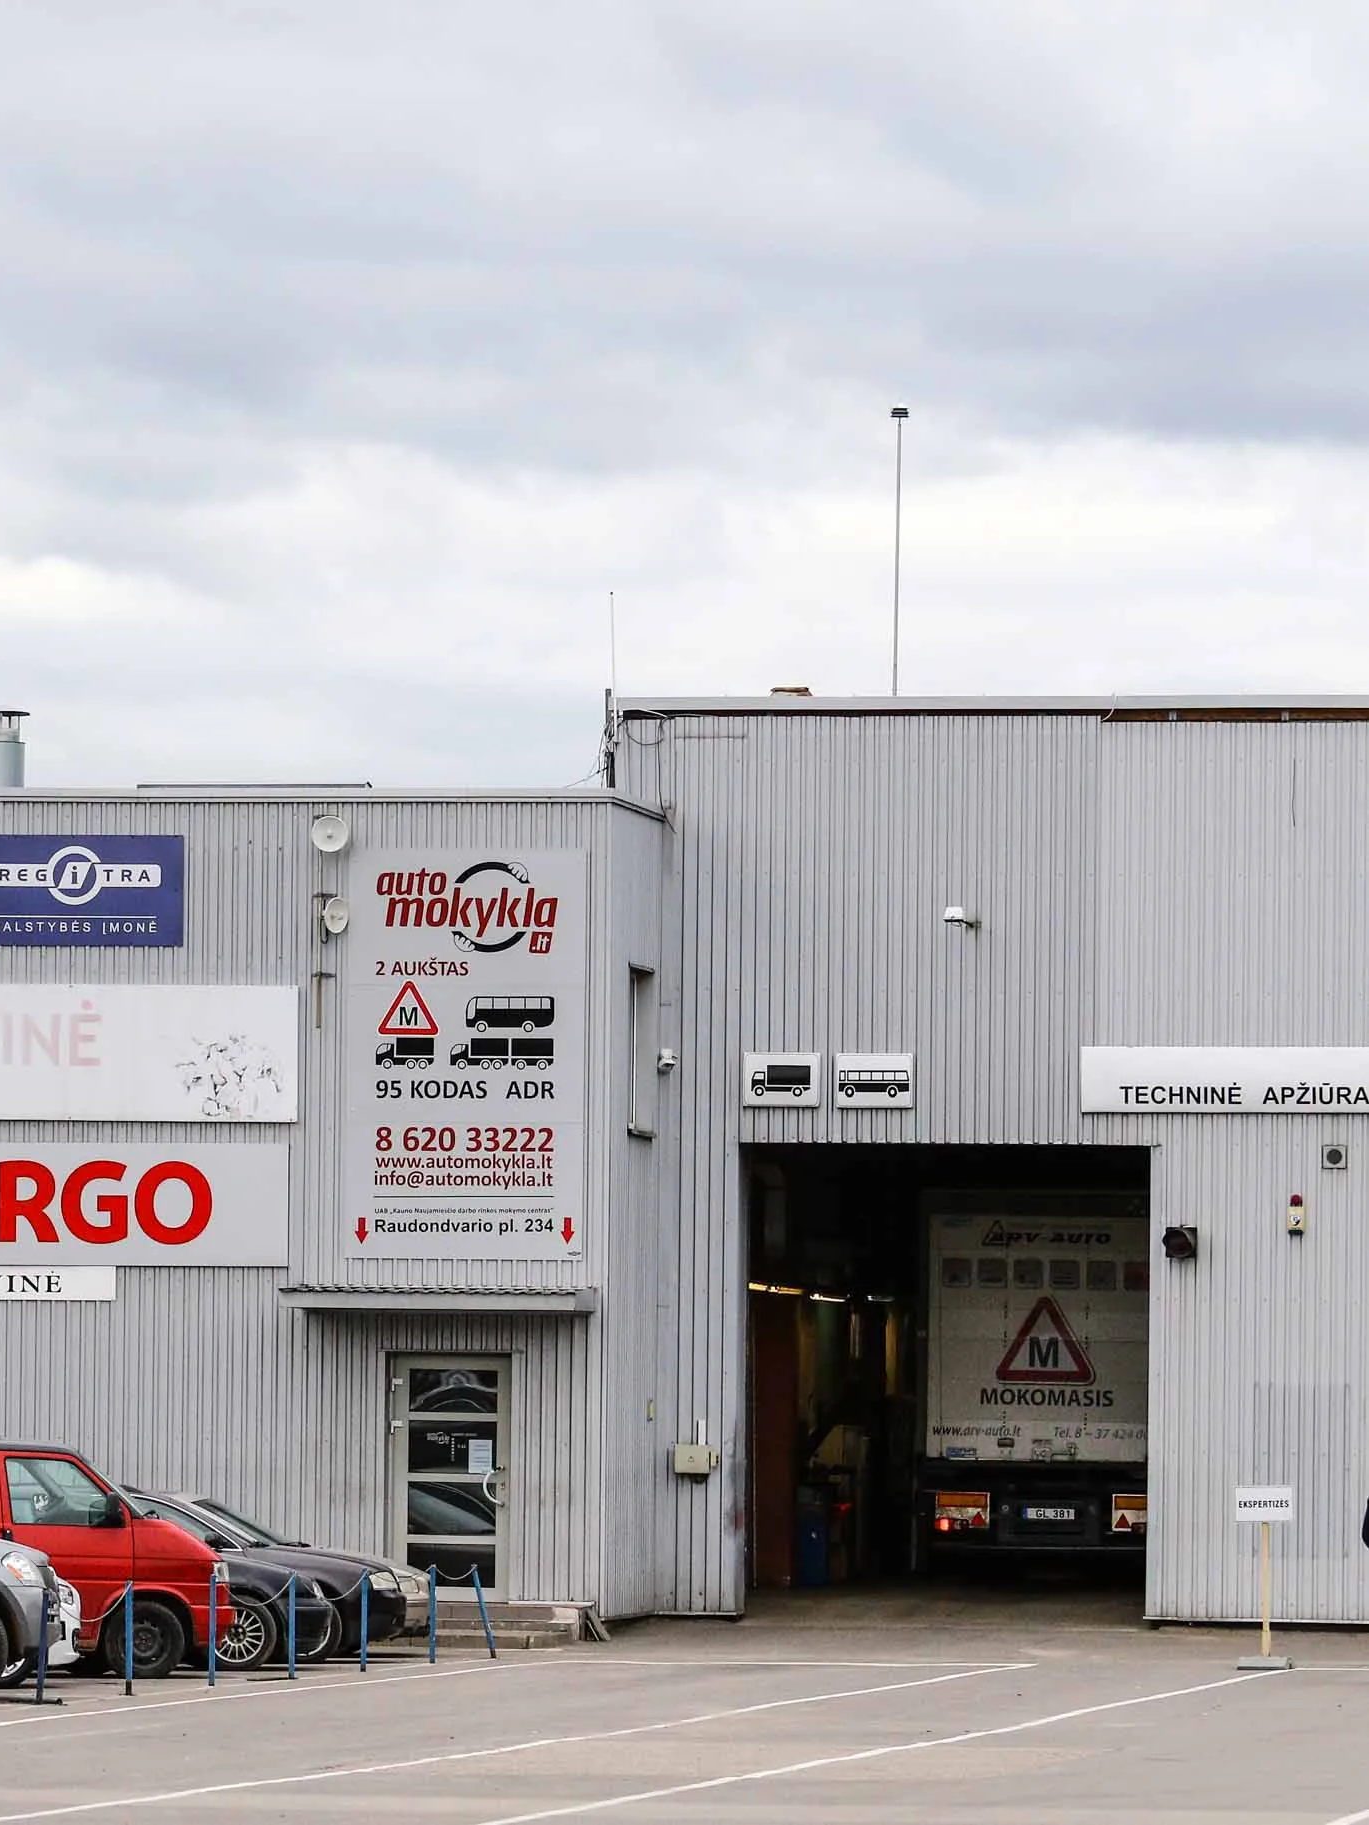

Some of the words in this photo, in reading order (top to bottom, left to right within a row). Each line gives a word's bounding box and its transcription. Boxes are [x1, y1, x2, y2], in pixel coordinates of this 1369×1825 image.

[376, 868, 447, 896] auto
[385, 887, 559, 937] mokykla
[102, 920, 158, 935] ĮMONĖ
[375, 961, 386, 976] 2
[391, 957, 469, 976] AUKŠTAS
[399, 1007, 418, 1026] M
[375, 1080, 402, 1099] 95
[411, 1080, 488, 1099] KODAS
[506, 1081, 555, 1099] ADR
[1119, 1082, 1243, 1105] TECHNINĖ
[1262, 1082, 1369, 1105] APŽIŪRA
[375, 1127, 392, 1152] 8
[403, 1127, 456, 1152] 620
[466, 1127, 554, 1152] 33222
[375, 1153, 553, 1172] www.automokykla.lt
[374, 1171, 554, 1189] info@automokykla.lt
[374, 1218, 493, 1232] Raudondvario
[499, 1218, 518, 1235] pl.
[524, 1218, 554, 1232] 234
[1029, 1336, 1059, 1368] M
[981, 1387, 1114, 1408] MOKOMASIS
[1054, 1426, 1072, 1438] Tel.
